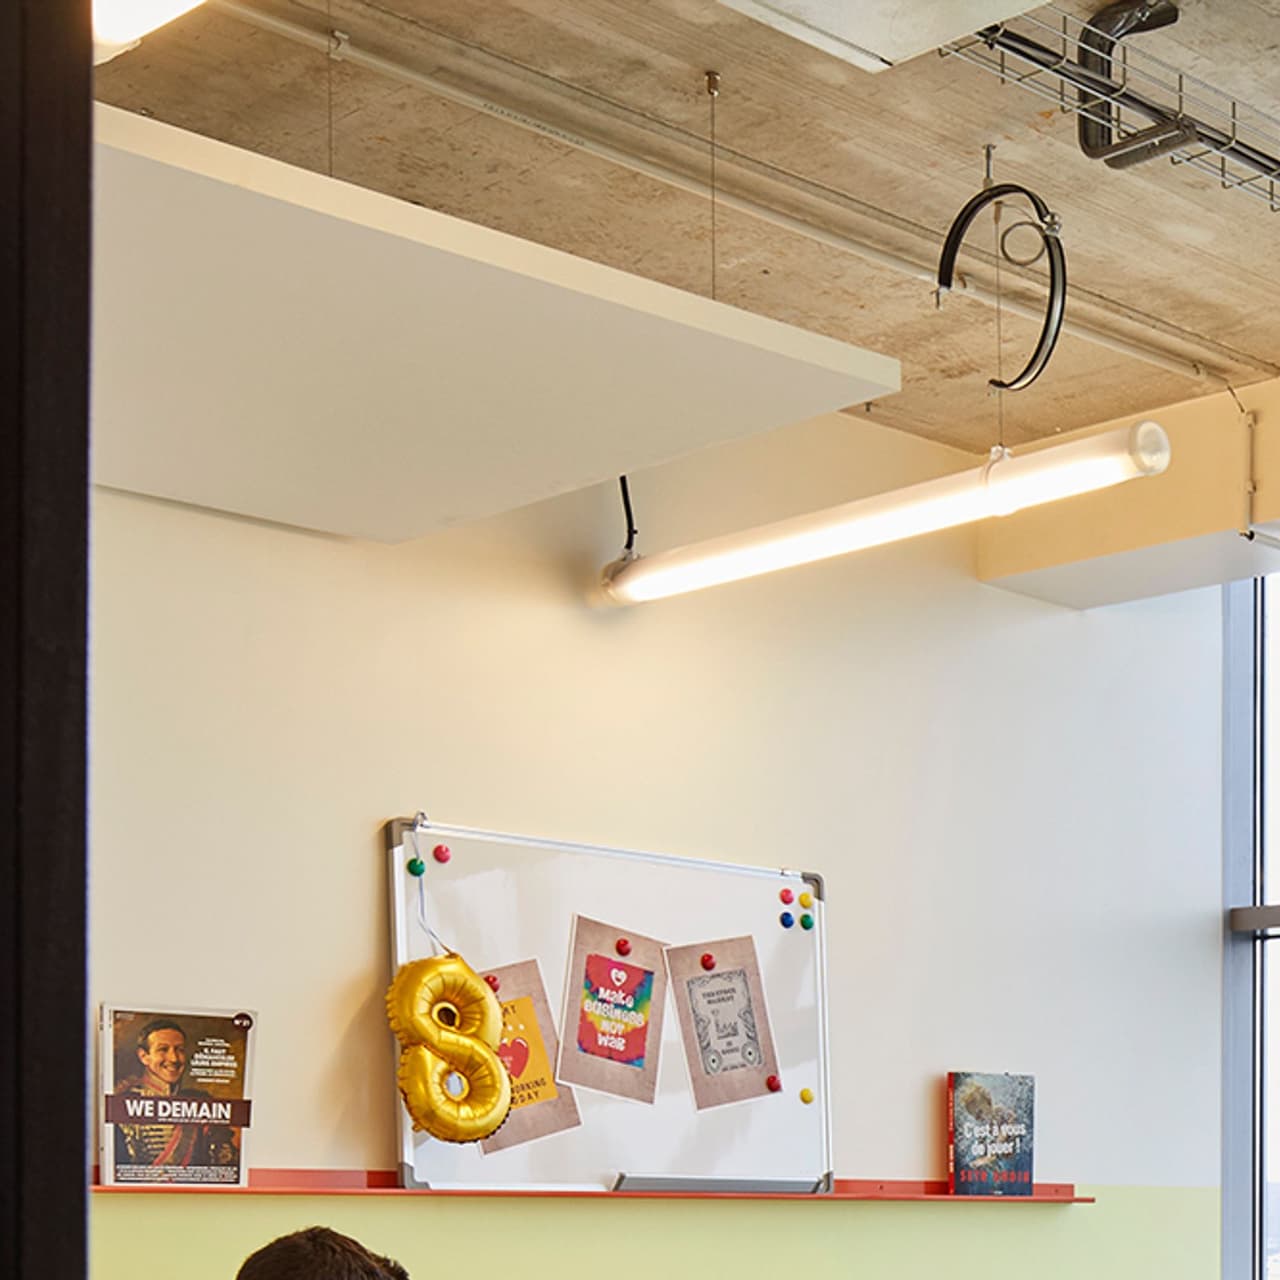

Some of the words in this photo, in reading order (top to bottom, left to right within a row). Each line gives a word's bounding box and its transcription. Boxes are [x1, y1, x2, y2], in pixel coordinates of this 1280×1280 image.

[510, 1090, 540, 1105] ODAY
[125, 1099, 155, 1117] WE
[158, 1101, 232, 1119] DEMAIN
